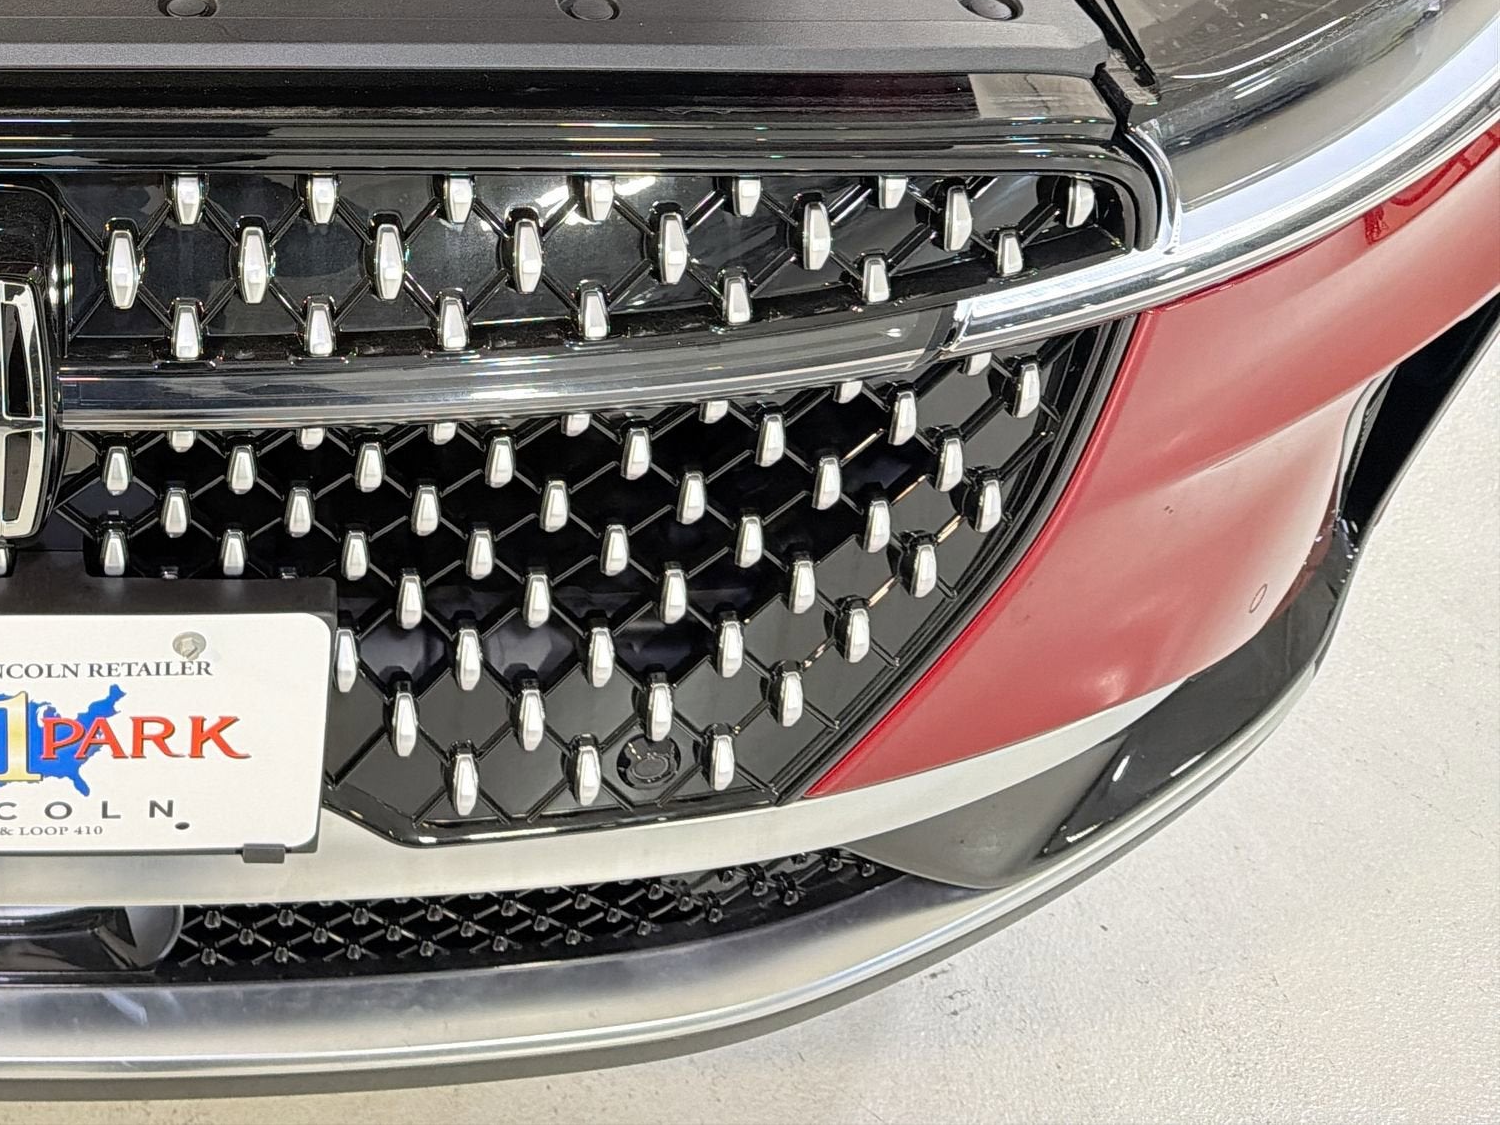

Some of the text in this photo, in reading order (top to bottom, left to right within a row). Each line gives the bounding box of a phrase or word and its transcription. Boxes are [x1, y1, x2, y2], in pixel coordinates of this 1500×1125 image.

[88, 661, 214, 679] RETAILER
[41, 715, 252, 760] PARK
[19, 826, 70, 836] LOOP
[73, 825, 104, 836] 410
